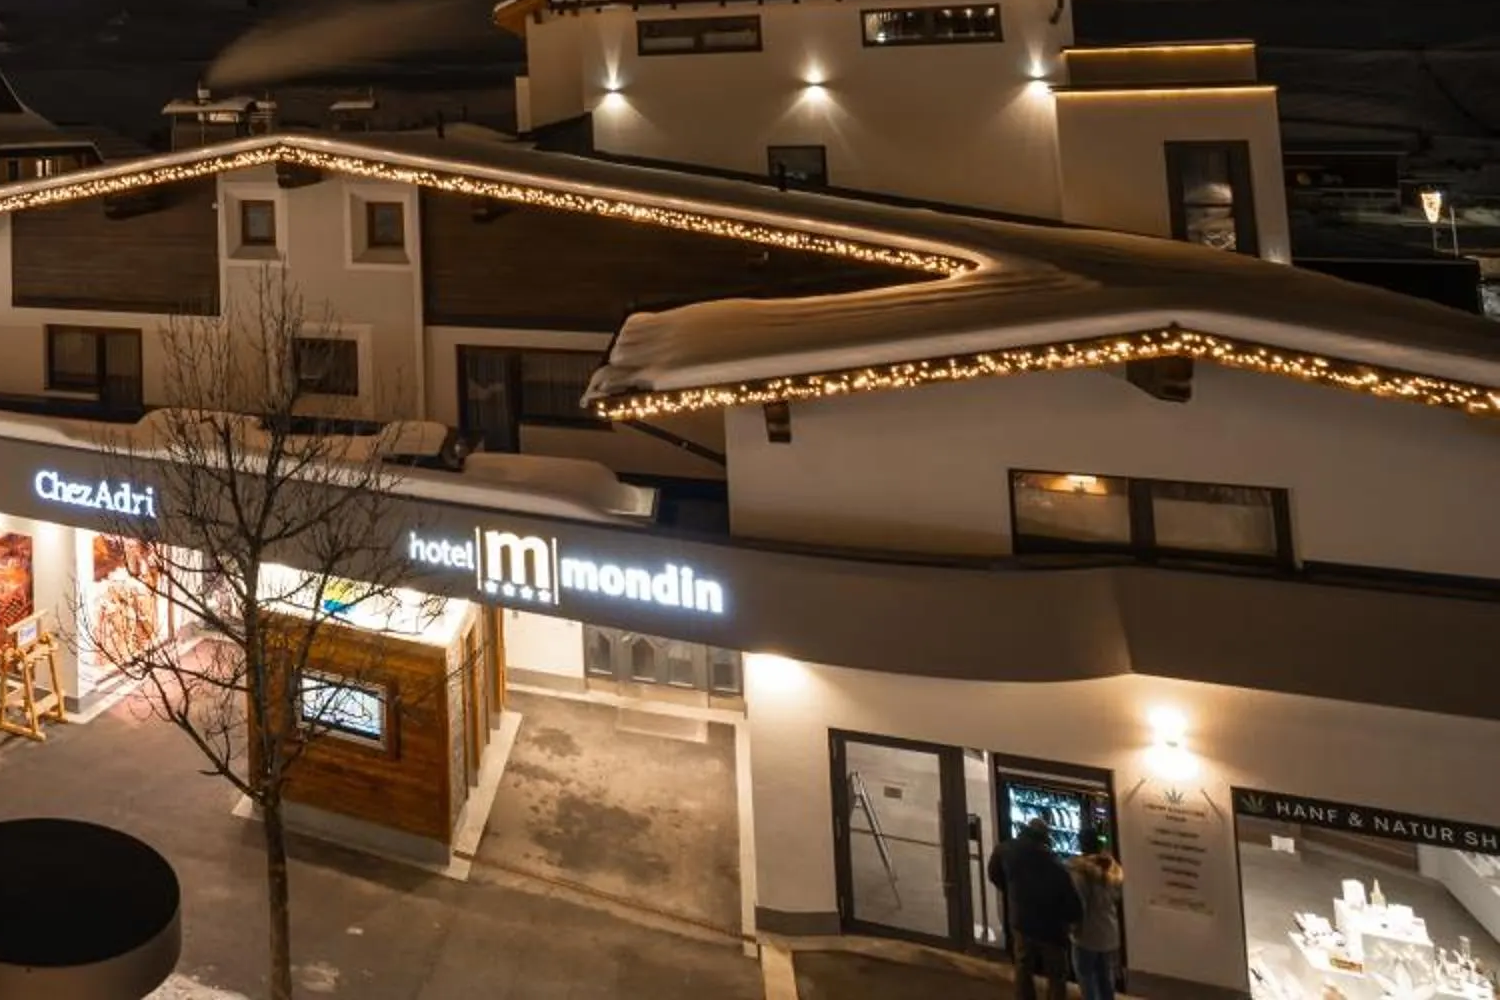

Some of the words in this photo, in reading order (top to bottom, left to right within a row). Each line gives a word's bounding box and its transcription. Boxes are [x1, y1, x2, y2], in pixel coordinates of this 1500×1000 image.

[409, 531, 475, 570] hotel
[561, 555, 725, 613] mondin
[1276, 801, 1338, 823] HANF
[1348, 811, 1364, 827] &
[1373, 815, 1454, 843] NATUR
